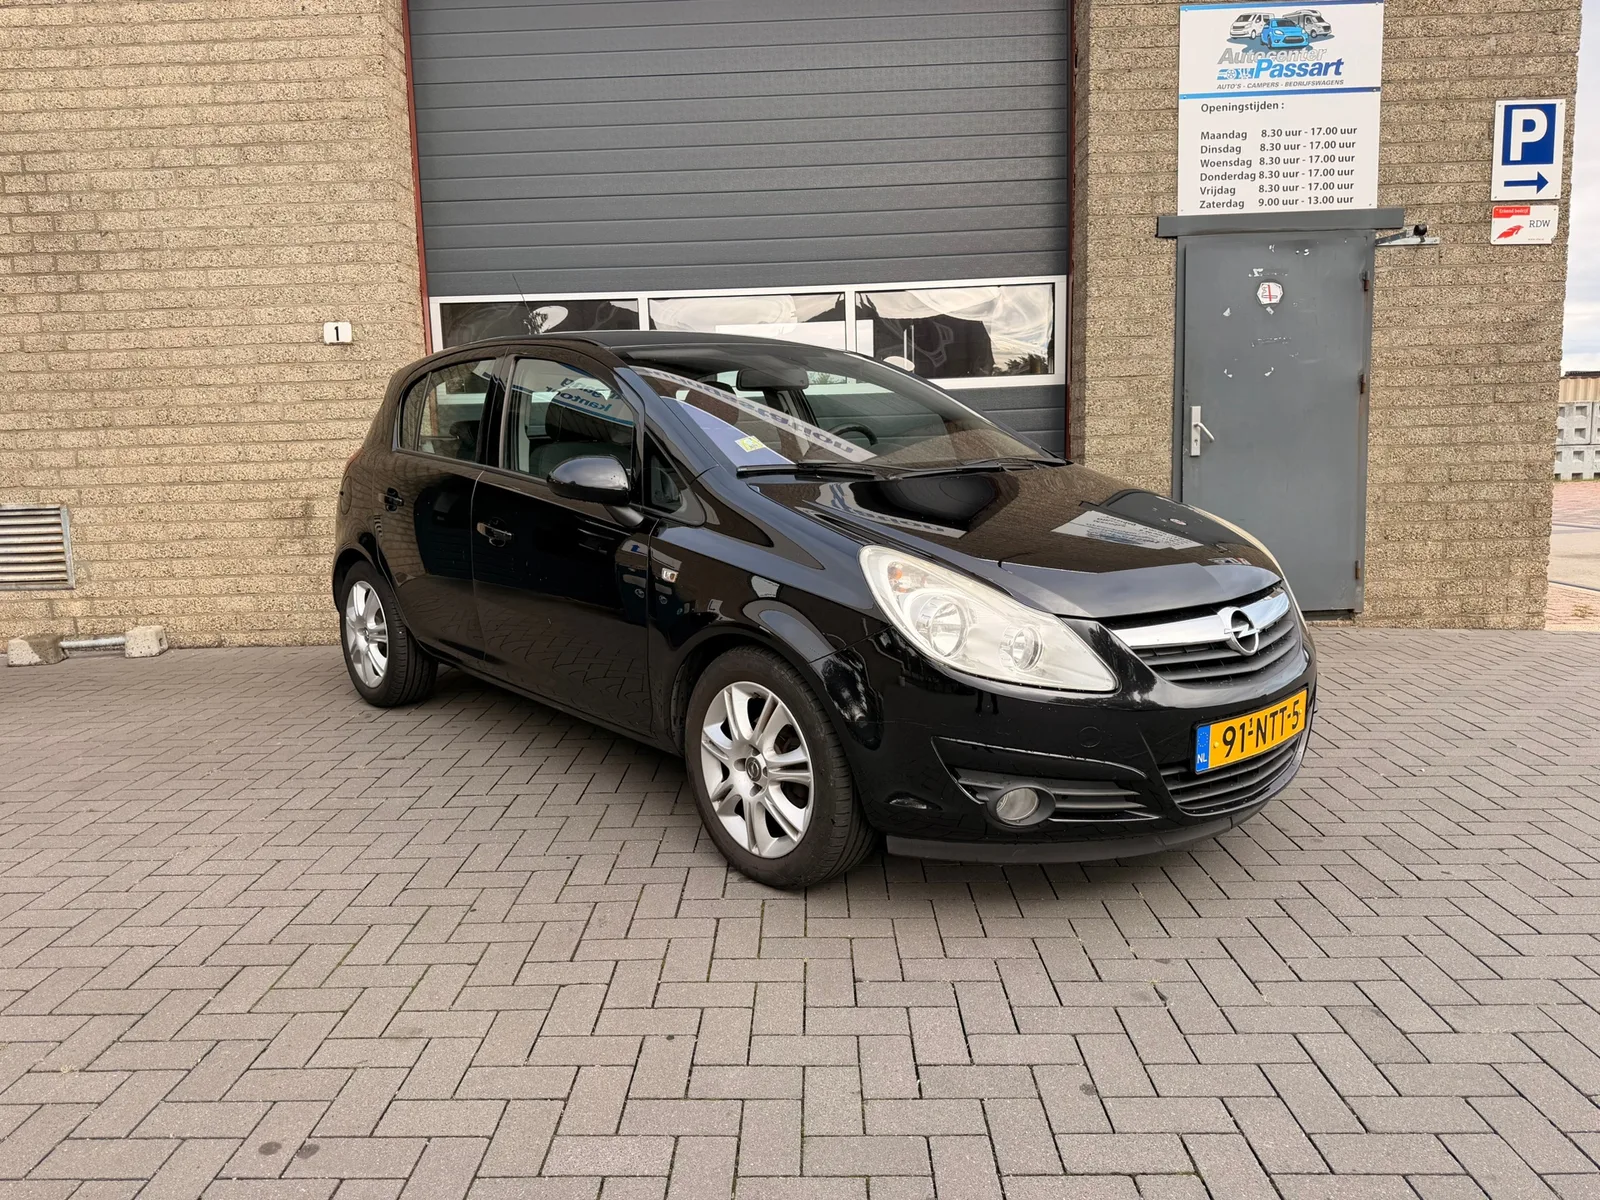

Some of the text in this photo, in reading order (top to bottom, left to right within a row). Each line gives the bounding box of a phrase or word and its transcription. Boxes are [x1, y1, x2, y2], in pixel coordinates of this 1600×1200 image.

[1217, 48, 1327, 65] Autocenter
[1254, 58, 1344, 79] Passart
[1247, 81, 1279, 89] CAMPERS
[1284, 79, 1344, 87] BEDRIJFSWAGENS
[1200, 100, 1279, 114] Openingstijden
[1200, 130, 1247, 141] Maandag
[1261, 128, 1283, 138] 8.30
[1284, 129, 1302, 137] uur
[1311, 126, 1338, 136] 17.00
[1340, 127, 1358, 135] uur
[1510, 109, 1548, 161] P
[1200, 144, 1242, 155] Dinsdag
[1259, 142, 1281, 152] 8.30
[1283, 143, 1301, 151] uur
[1309, 140, 1337, 150] 17.00
[1338, 141, 1356, 149] uur
[1200, 157, 1252, 168] Woensdag
[1259, 156, 1281, 166] 8.30
[1283, 157, 1300, 165] uur
[1309, 154, 1336, 164] 17.00
[1337, 155, 1355, 163] uur
[1200, 171, 1256, 182] Donderdag
[1258, 170, 1280, 179] 8.30
[1282, 171, 1300, 179] uur
[1308, 168, 1335, 177] 17.00
[1337, 169, 1355, 177] uur
[1199, 185, 1236, 197] Vrijdag
[1258, 184, 1280, 193] 8.30
[1308, 182, 1335, 191] 17.00
[1337, 182, 1354, 190] uur
[1199, 199, 1245, 210] Zaterdag
[1258, 197, 1280, 207] 9.00
[1281, 198, 1299, 206] uur
[1308, 195, 1335, 205] 13.00
[1336, 196, 1354, 204] uur
[1529, 219, 1551, 228] RDW
[334, 325, 339, 341] 1
[1197, 753, 1207, 764] NL
